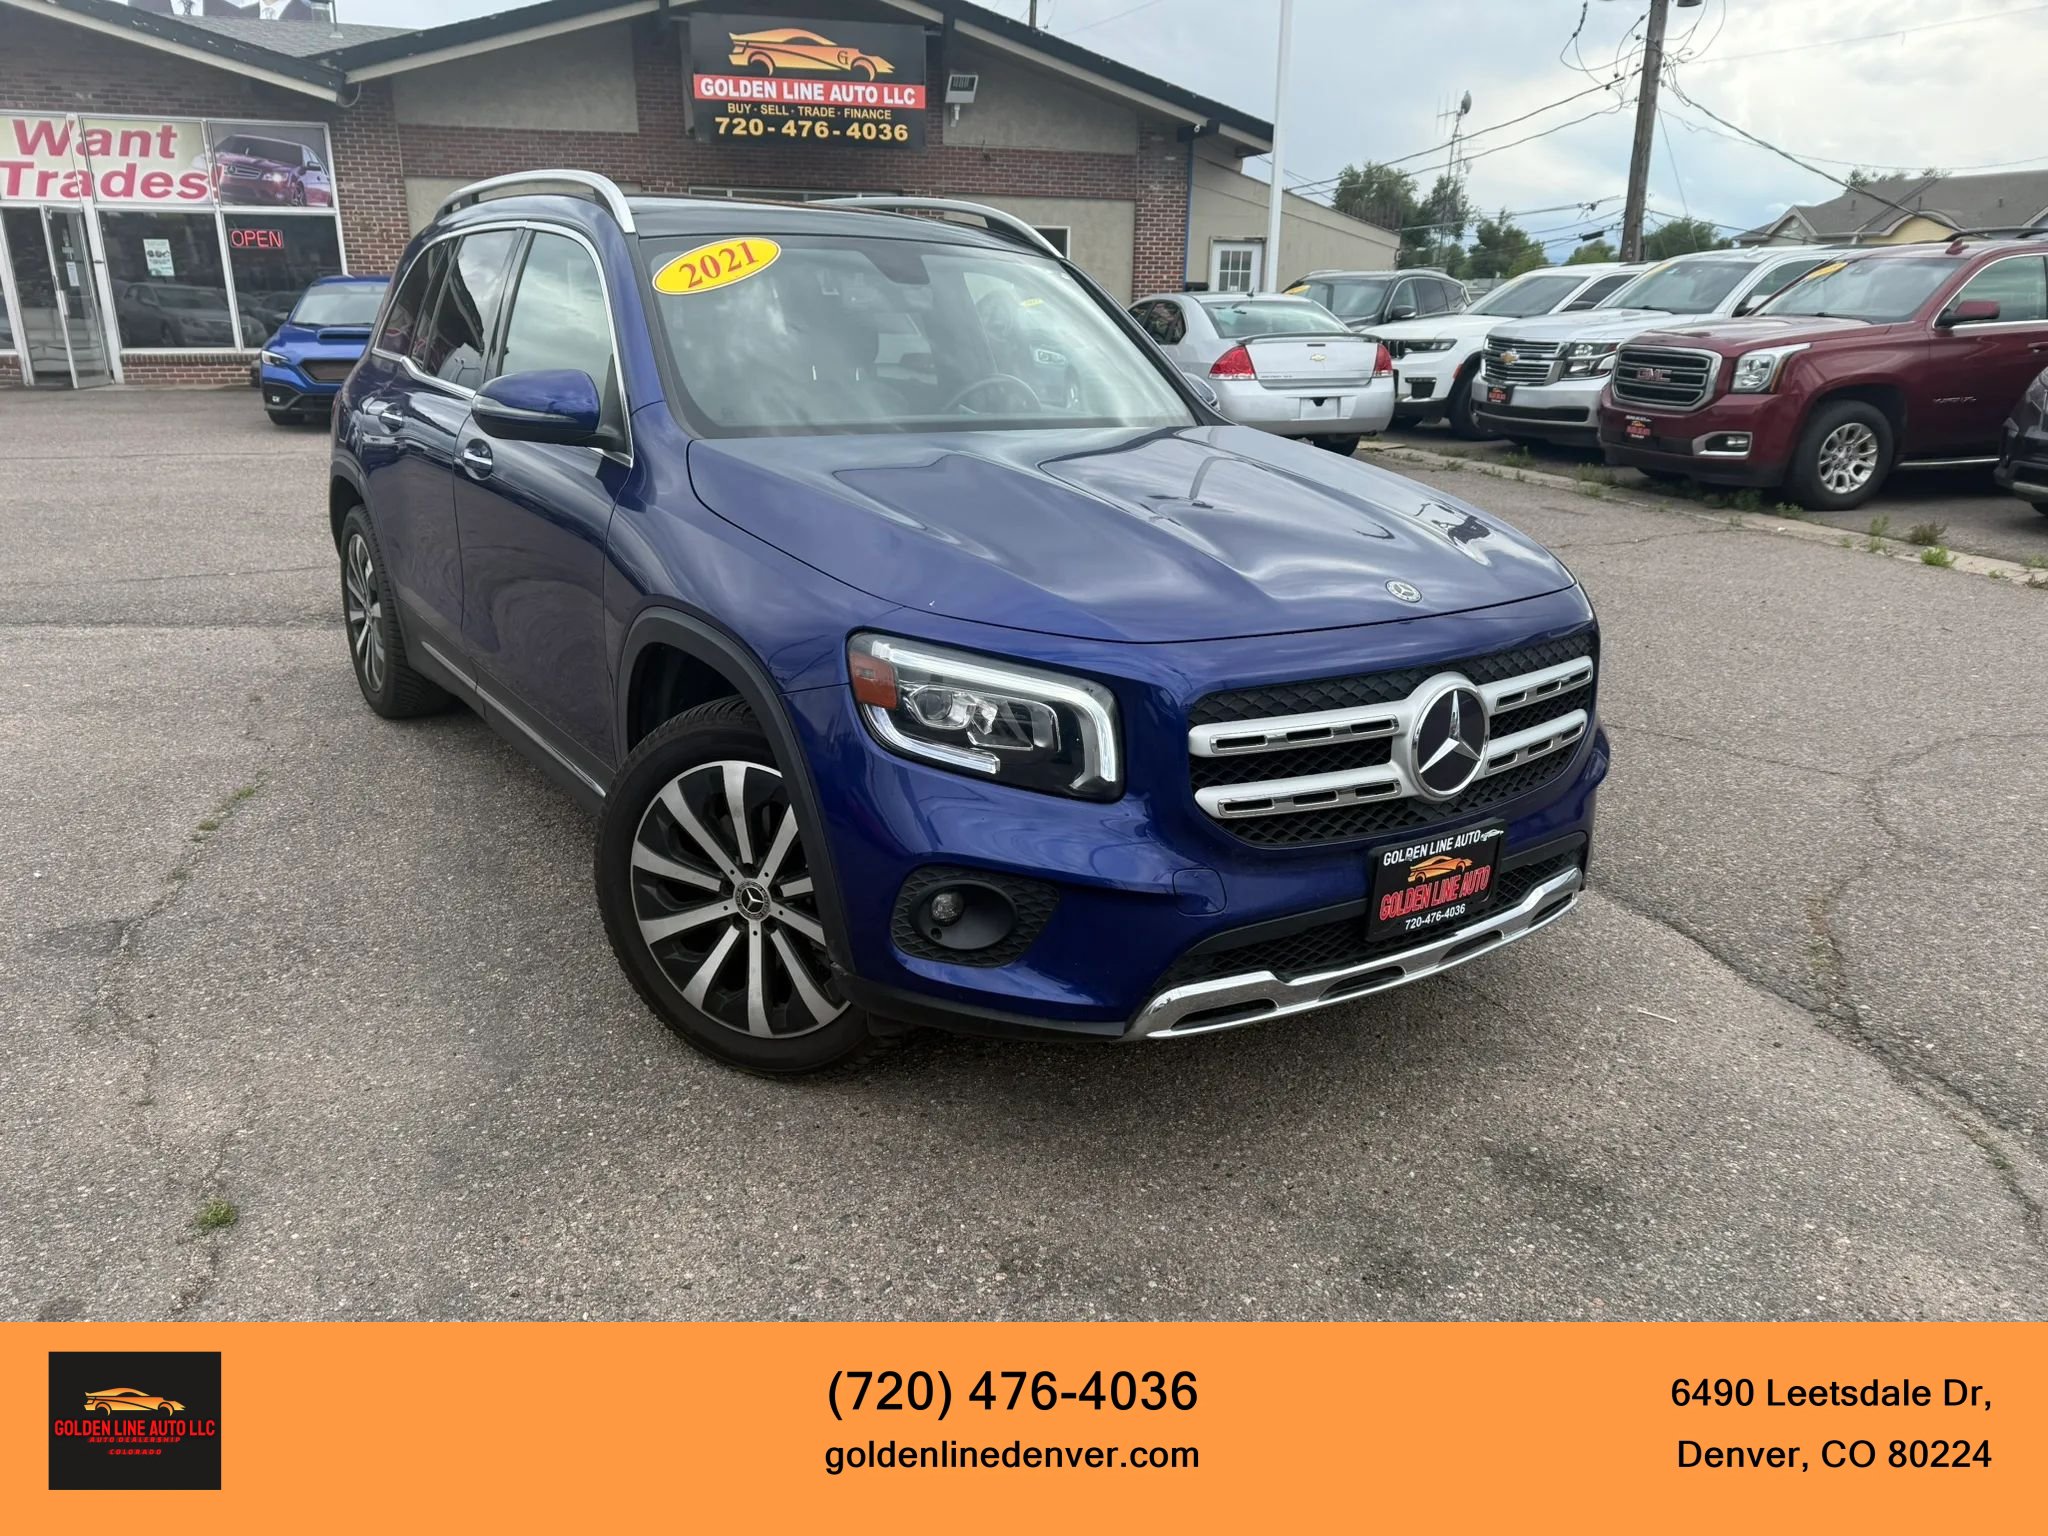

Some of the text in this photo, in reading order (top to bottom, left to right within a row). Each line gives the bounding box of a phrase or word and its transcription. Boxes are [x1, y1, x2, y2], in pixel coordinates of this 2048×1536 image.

[700, 77, 916, 105] GOLDEN LINE AUTO LLC
[727, 103, 892, 120] BUY SELL TRADE FINANCE
[12, 119, 178, 159] Want
[231, 230, 282, 248] OPEN
[679, 241, 759, 289] 2021
[1637, 367, 1672, 383] GMC
[1383, 829, 1481, 866] GOLDEN LINE AUTO
[1380, 865, 1491, 920] GOLDEN LINE AUTO
[1405, 903, 1466, 930] 720-476-4036
